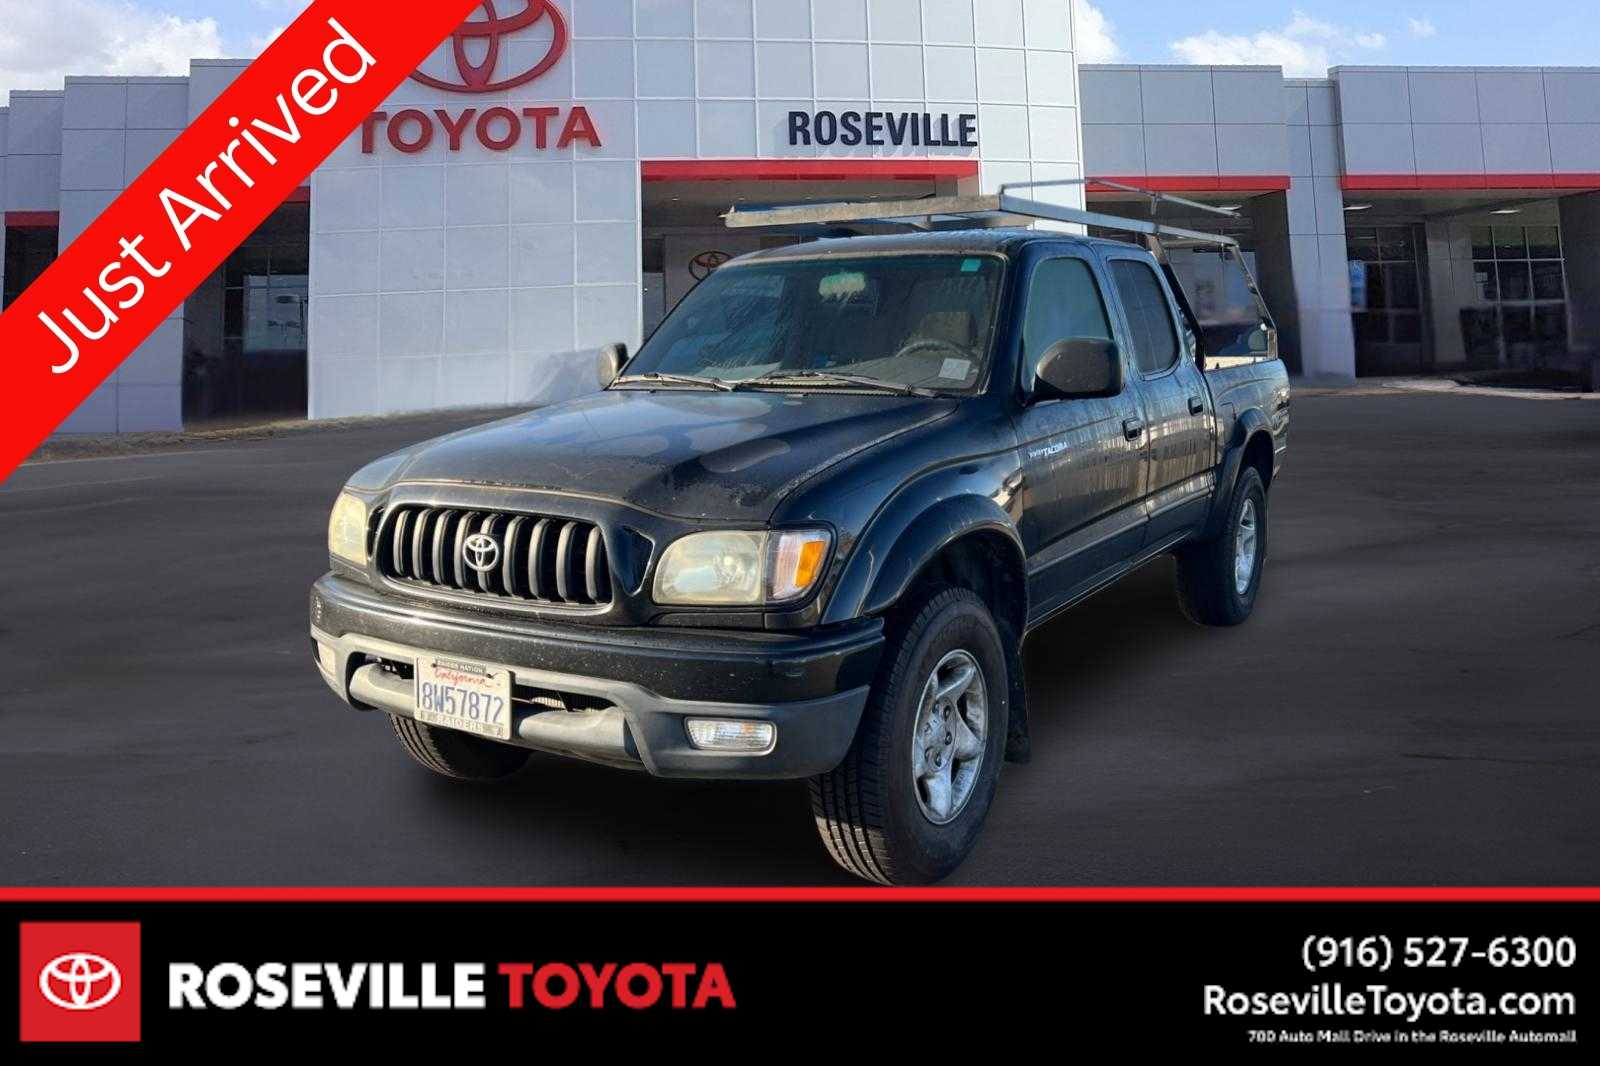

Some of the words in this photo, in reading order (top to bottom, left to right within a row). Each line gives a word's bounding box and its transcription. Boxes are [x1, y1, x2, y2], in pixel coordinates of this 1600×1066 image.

[361, 106, 603, 154] TOYOTA
[788, 111, 978, 147] ROSEVILLE
[422, 682, 504, 726] 8W57872
